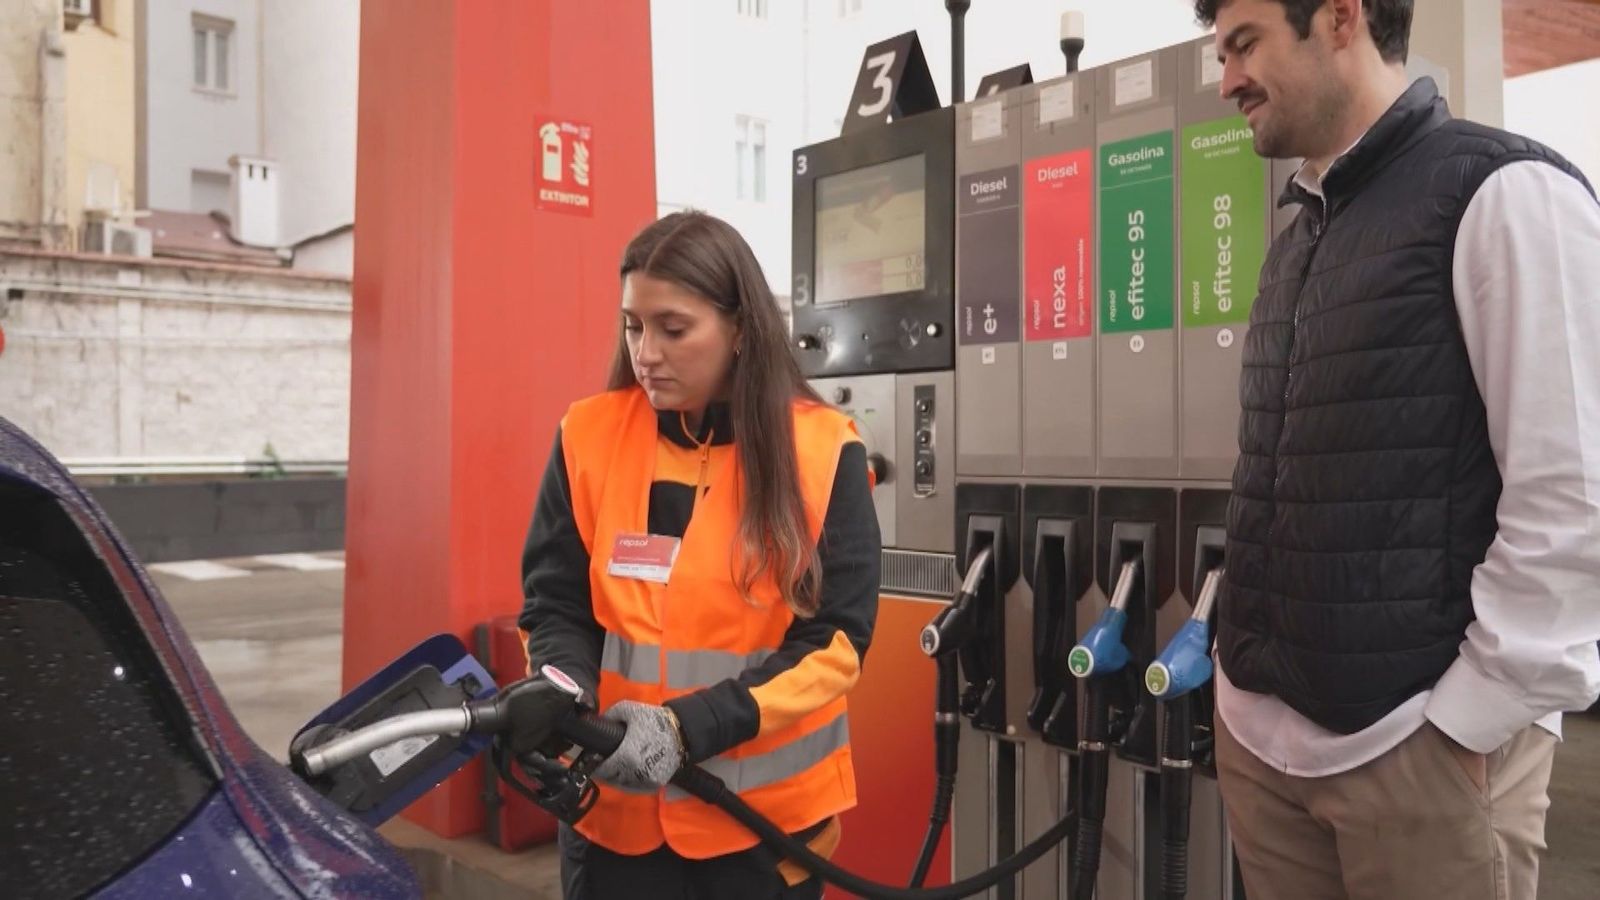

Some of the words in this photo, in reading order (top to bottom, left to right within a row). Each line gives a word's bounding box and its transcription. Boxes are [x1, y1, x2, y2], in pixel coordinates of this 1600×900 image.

[857, 51, 896, 117] 3
[1191, 127, 1254, 150] Gasolina
[796, 155, 808, 175] 3
[1037, 161, 1079, 182] Diesel
[1108, 146, 1165, 166] Gasolina
[540, 188, 590, 208] EXTINTOR
[970, 176, 1007, 196] Diesel
[1128, 209, 1145, 242] 95
[1213, 193, 1232, 230] 98
[1128, 247, 1145, 321] efitec
[1213, 235, 1232, 313] efitec
[1053, 265, 1067, 329] nexa
[1107, 289, 1117, 323] repsol
[1191, 280, 1200, 316] repsol
[982, 303, 998, 335] e+
[619, 537, 649, 549] repsol
